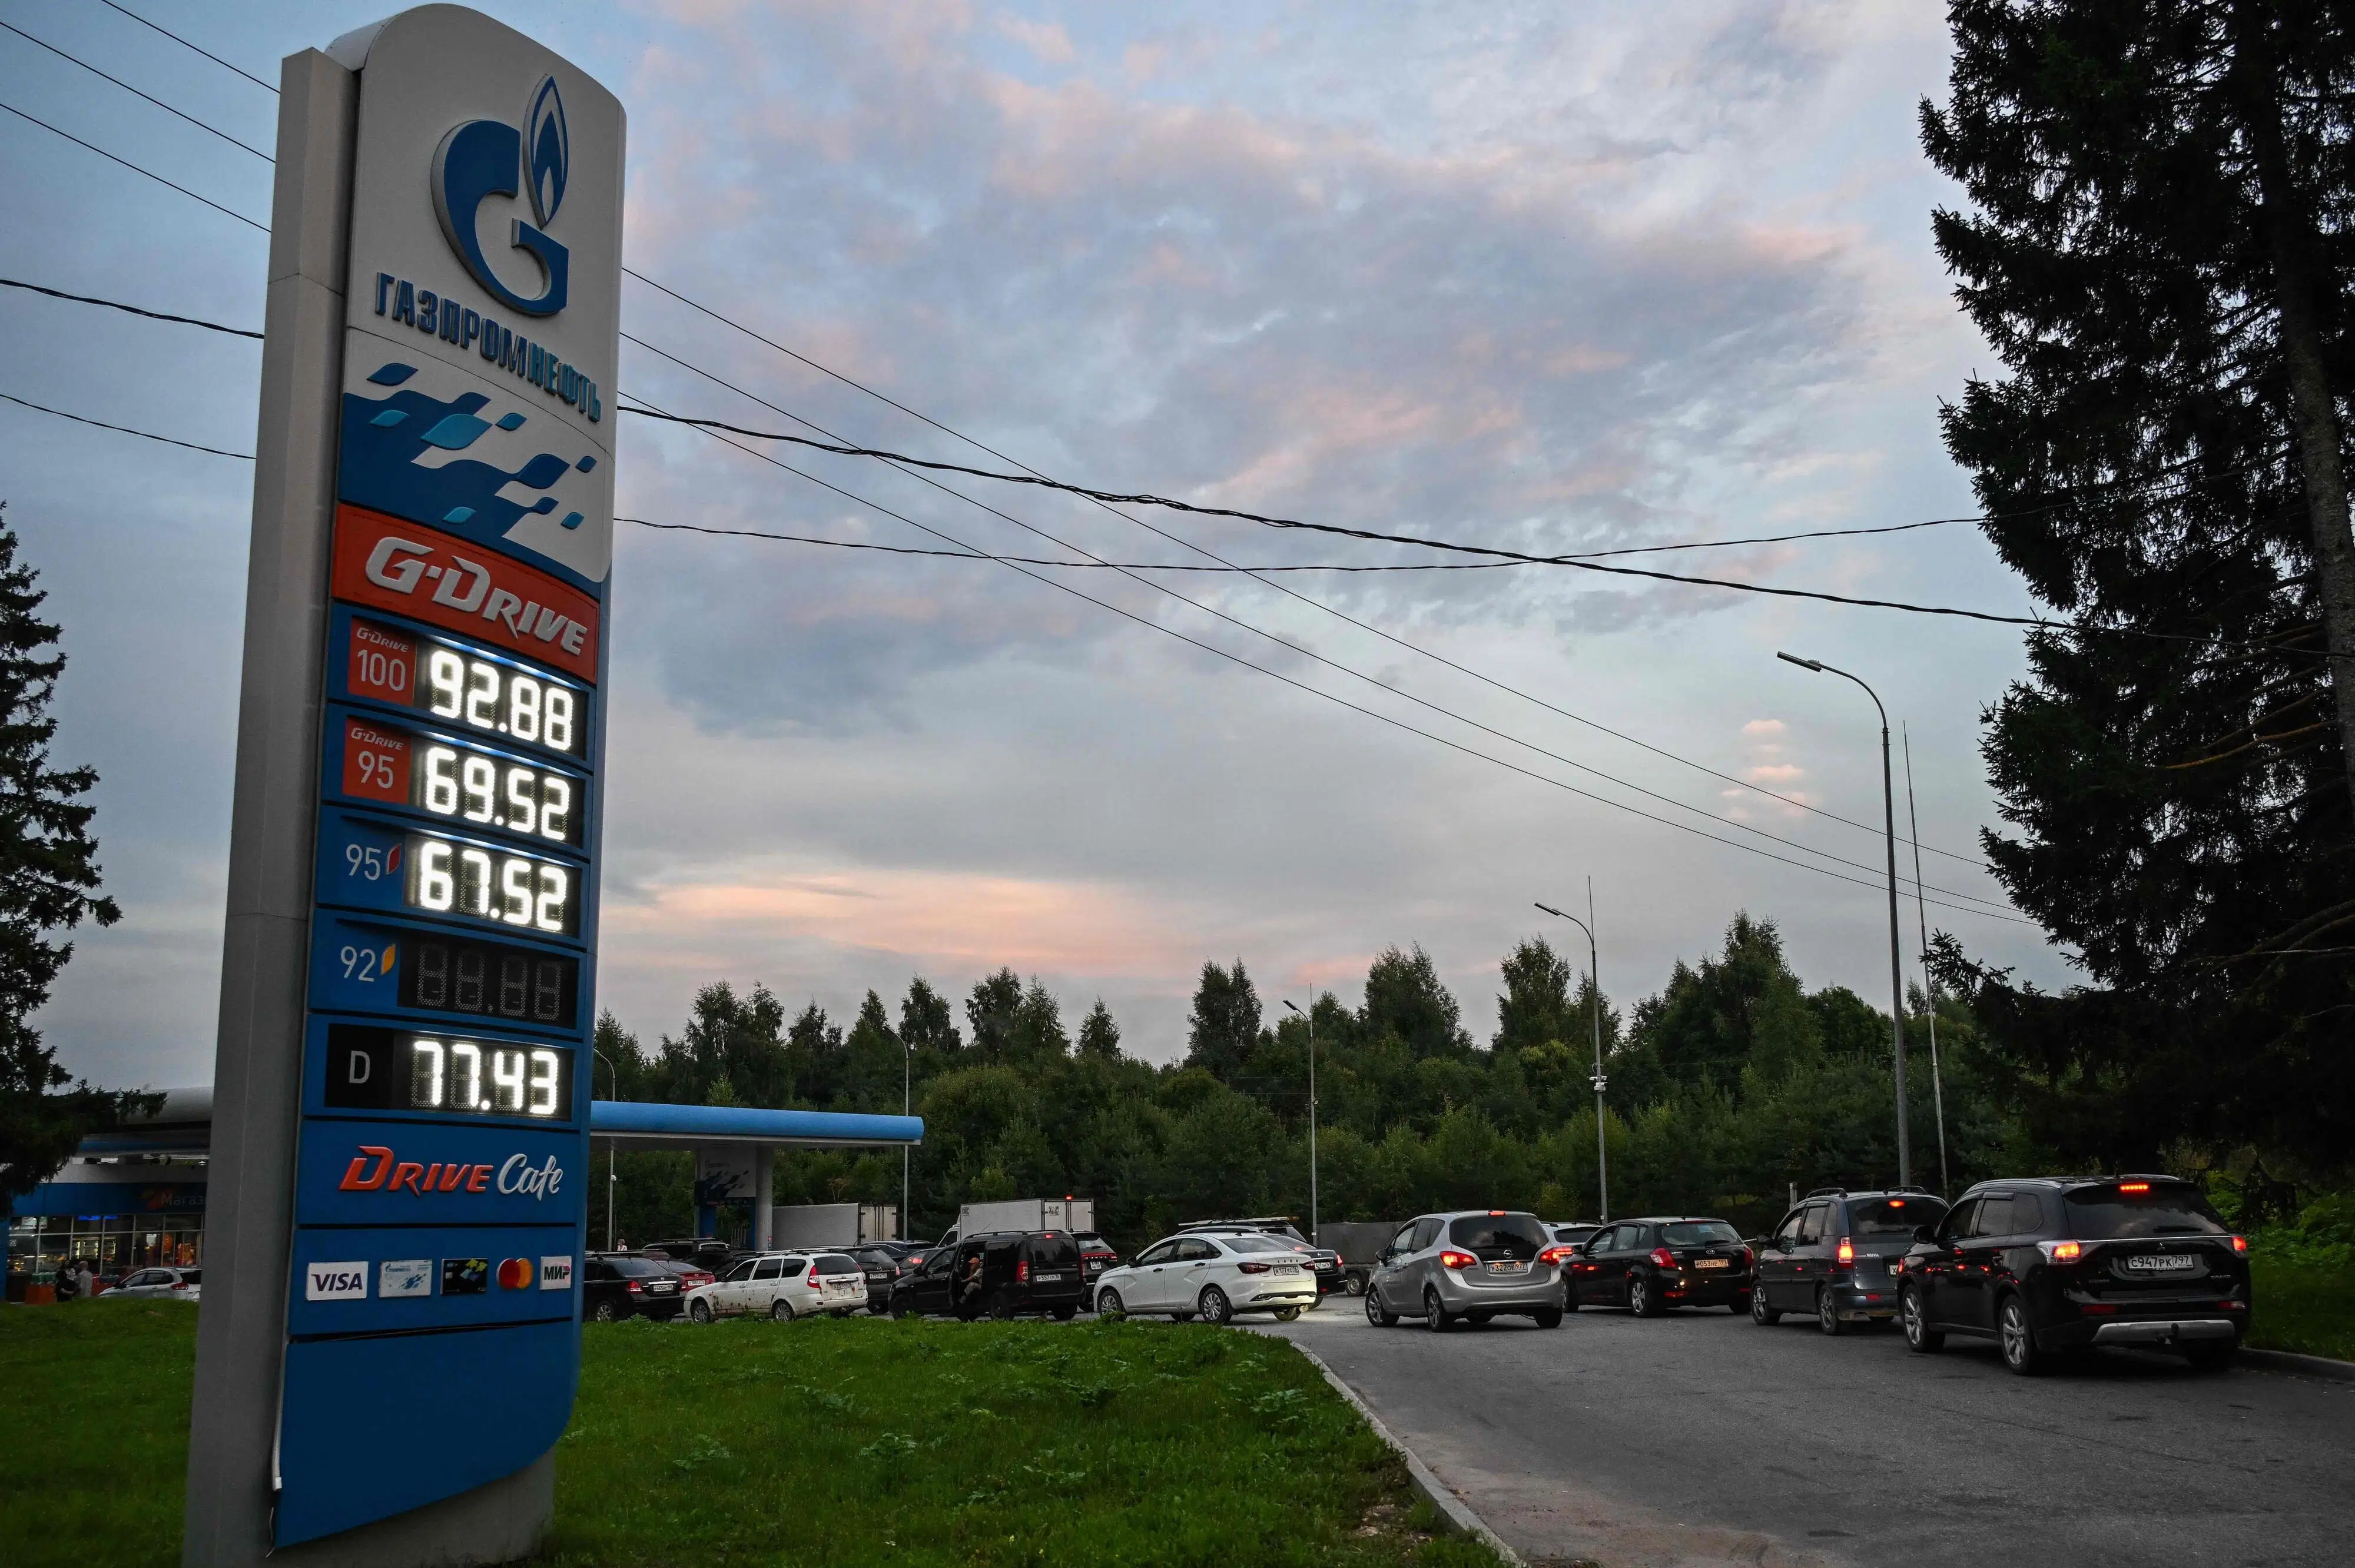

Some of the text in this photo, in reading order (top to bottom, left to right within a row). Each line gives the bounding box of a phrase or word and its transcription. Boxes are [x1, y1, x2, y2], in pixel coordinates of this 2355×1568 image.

[375, 272, 602, 423] ГАЗПРОМНЕФТЬ
[365, 537, 588, 656] G-DRIVE
[357, 649, 573, 751] 100 92.88
[358, 746, 570, 841] 95 69.52
[346, 841, 568, 931] 95 67.52
[340, 945, 376, 982] 92
[349, 1041, 559, 1114] D 77.43
[161, 1192, 204, 1205] Магаз
[339, 1145, 563, 1201] DRIVE Cafe
[311, 1273, 363, 1292] VISA
[543, 1266, 570, 1281] МИР
